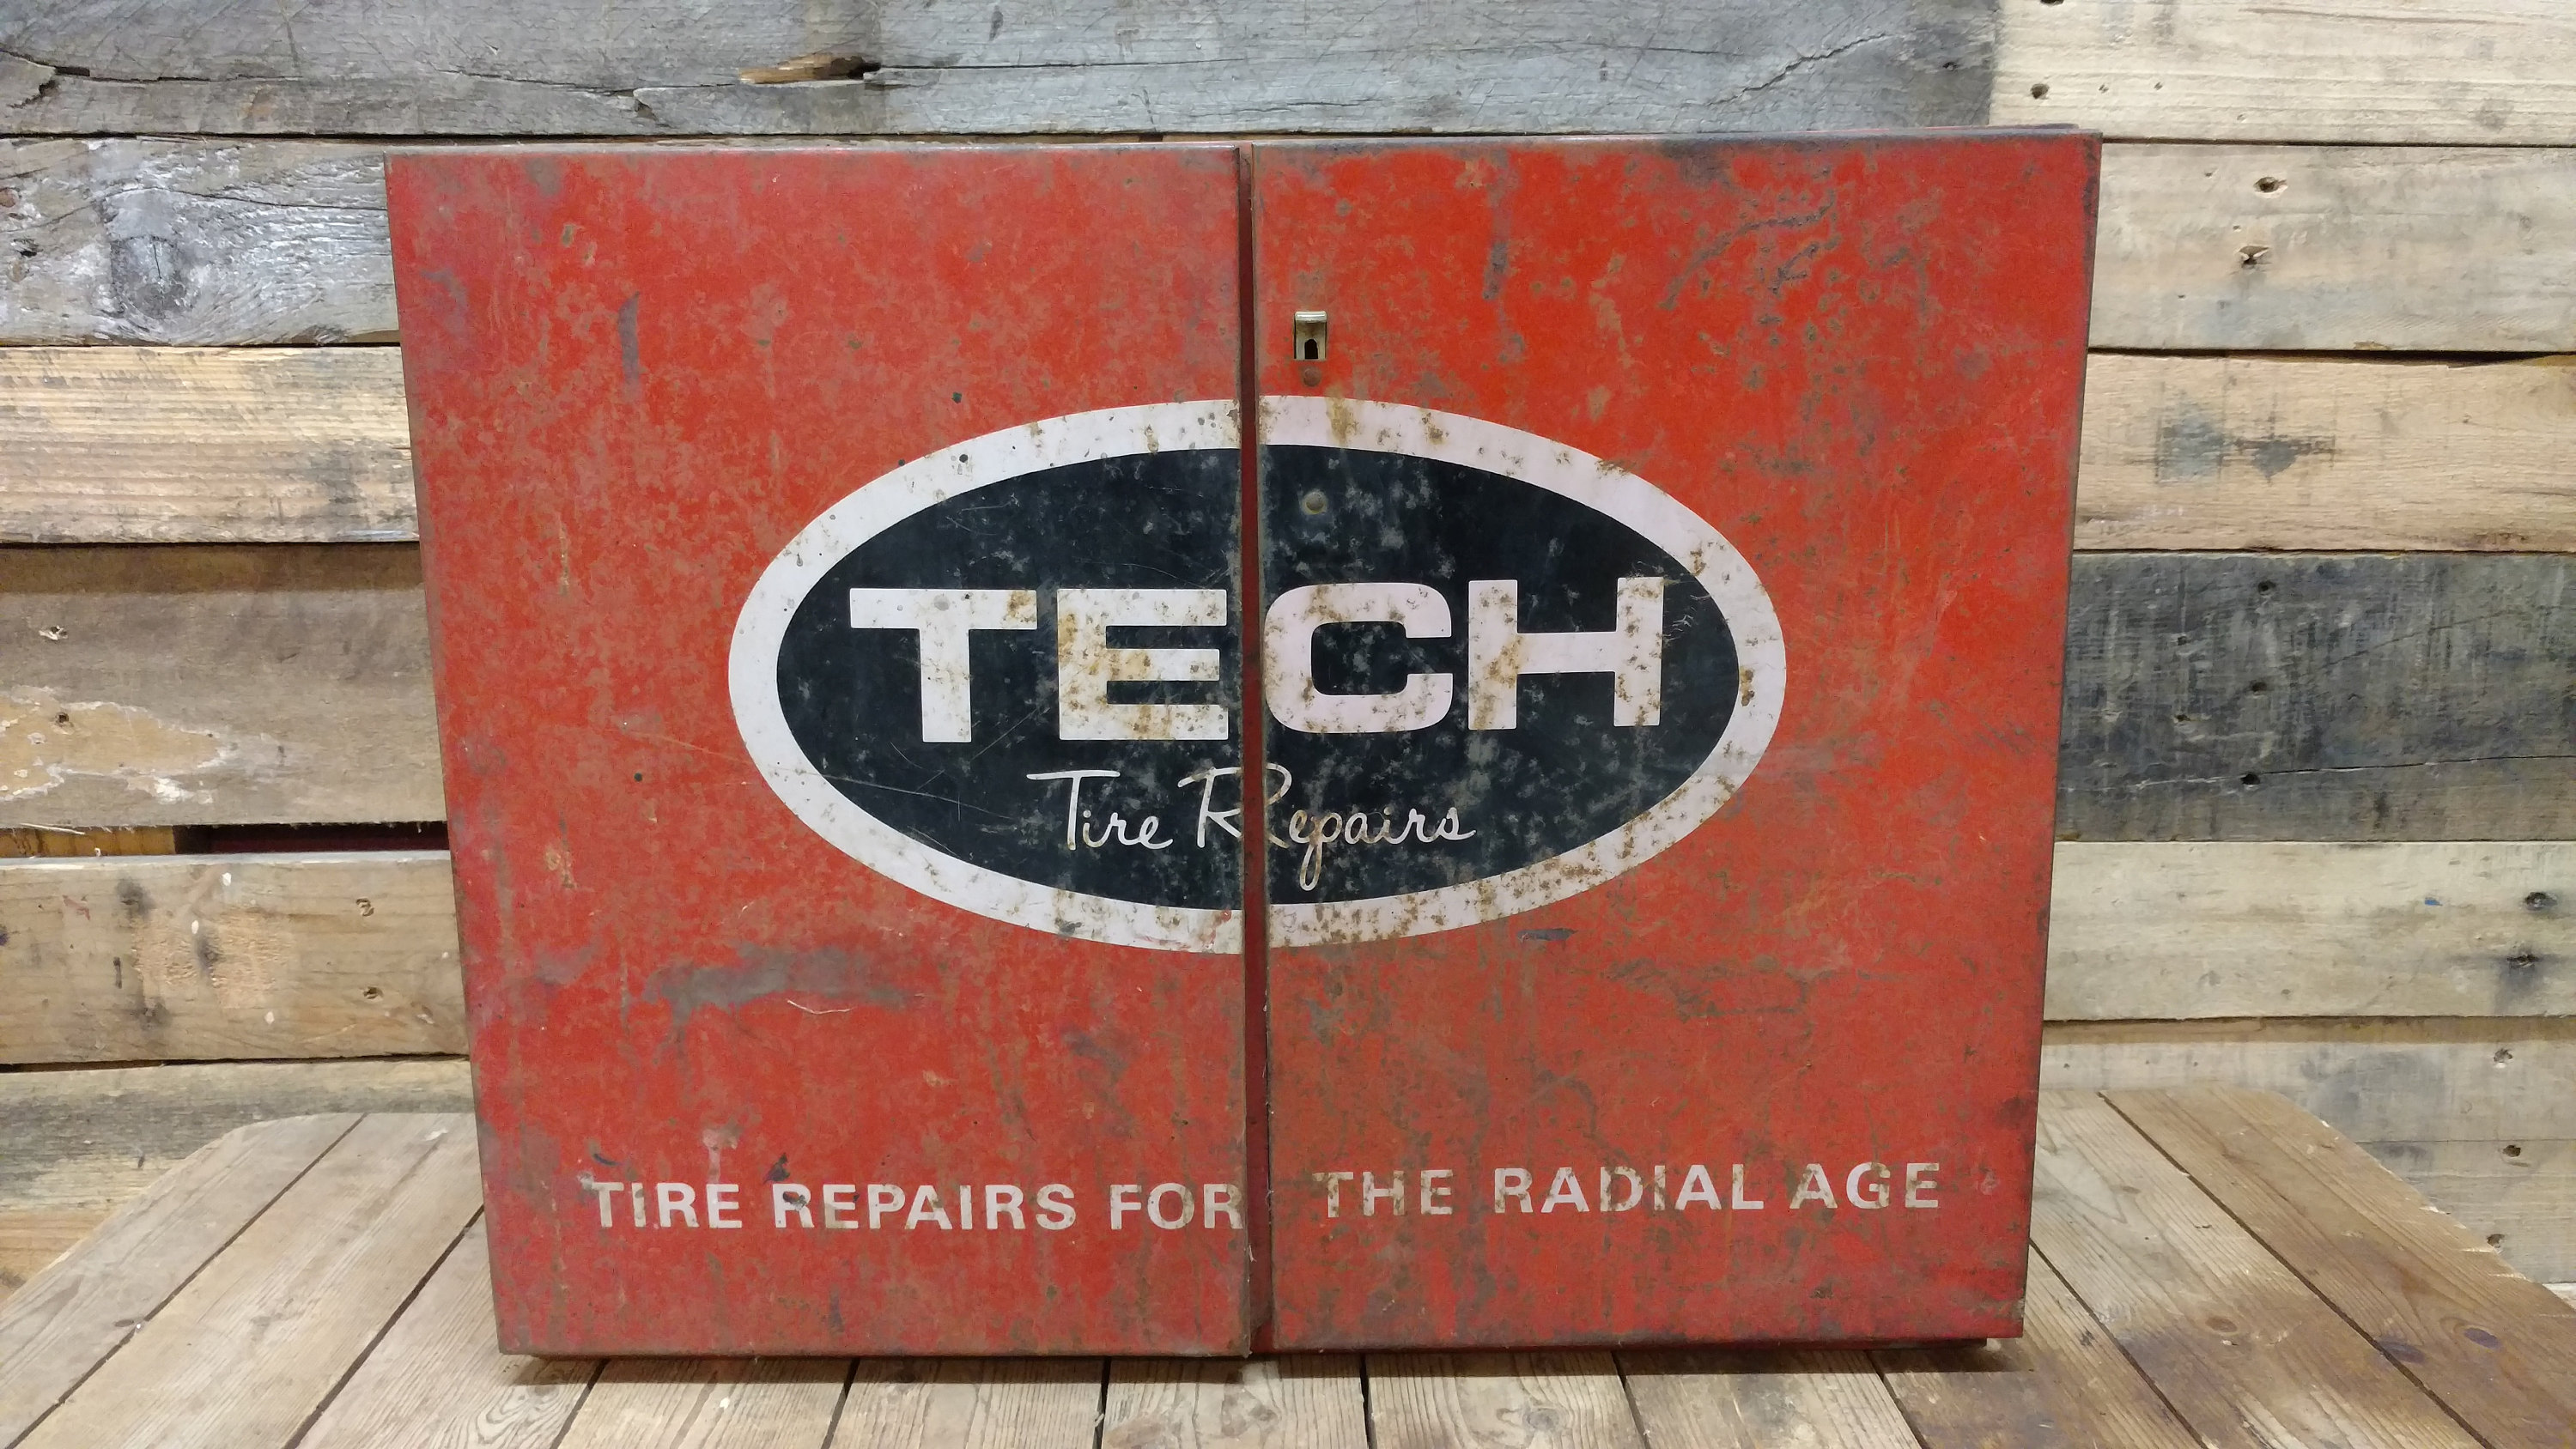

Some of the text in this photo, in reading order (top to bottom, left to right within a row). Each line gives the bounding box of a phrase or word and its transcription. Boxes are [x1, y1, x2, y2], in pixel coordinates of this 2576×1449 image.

[849, 576, 1665, 743] TECH
[1027, 762, 1476, 891] Tire Repairs
[592, 1161, 1940, 1231] TIRE REPAIRS FOR THE RADIAL AGE
